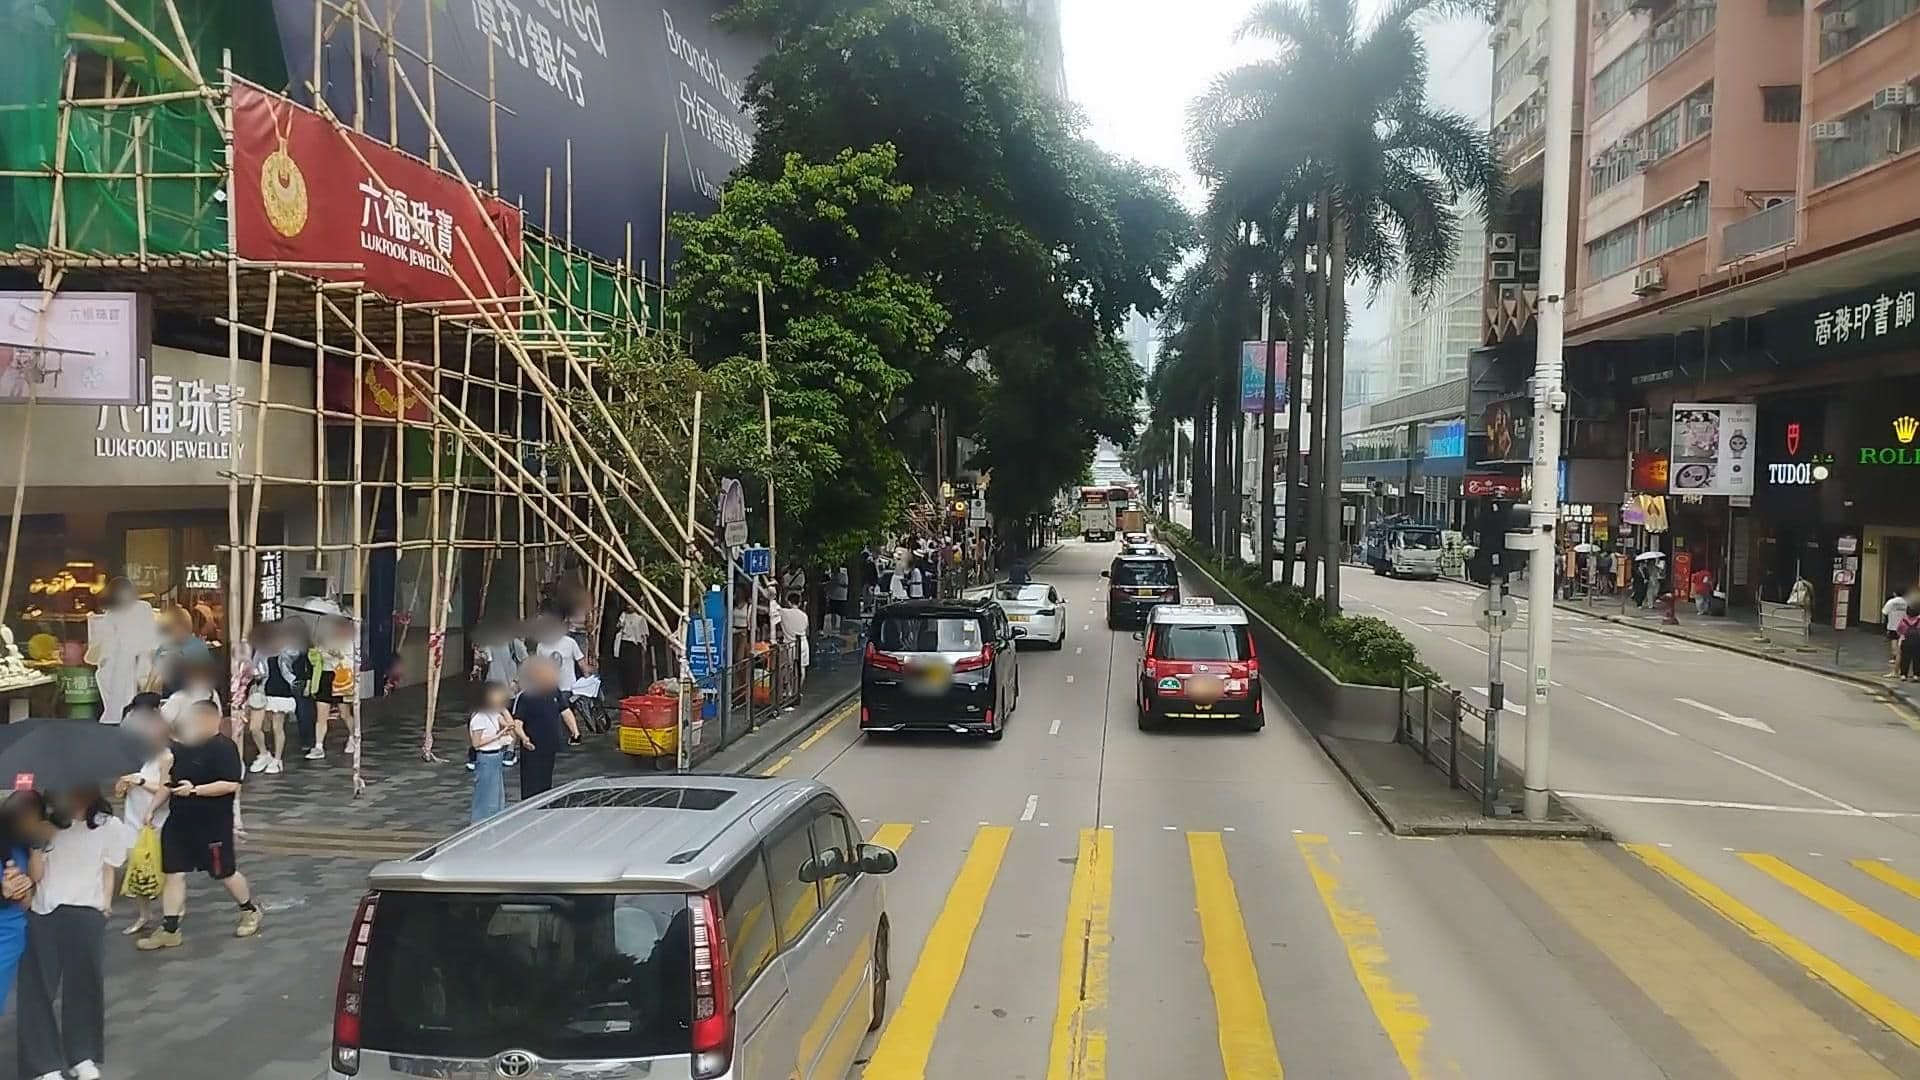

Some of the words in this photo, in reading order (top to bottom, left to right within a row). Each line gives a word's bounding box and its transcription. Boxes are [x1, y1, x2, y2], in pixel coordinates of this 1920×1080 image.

[662, 8, 719, 91] Branch
[359, 177, 453, 259] 六福珠寶
[360, 231, 409, 262] LUKFOOK
[1814, 291, 1916, 346] 商務印書館
[96, 438, 168, 458] LUKFOOK
[169, 439, 245, 463] JEWELLEY
[185, 564, 218, 582] 六福
